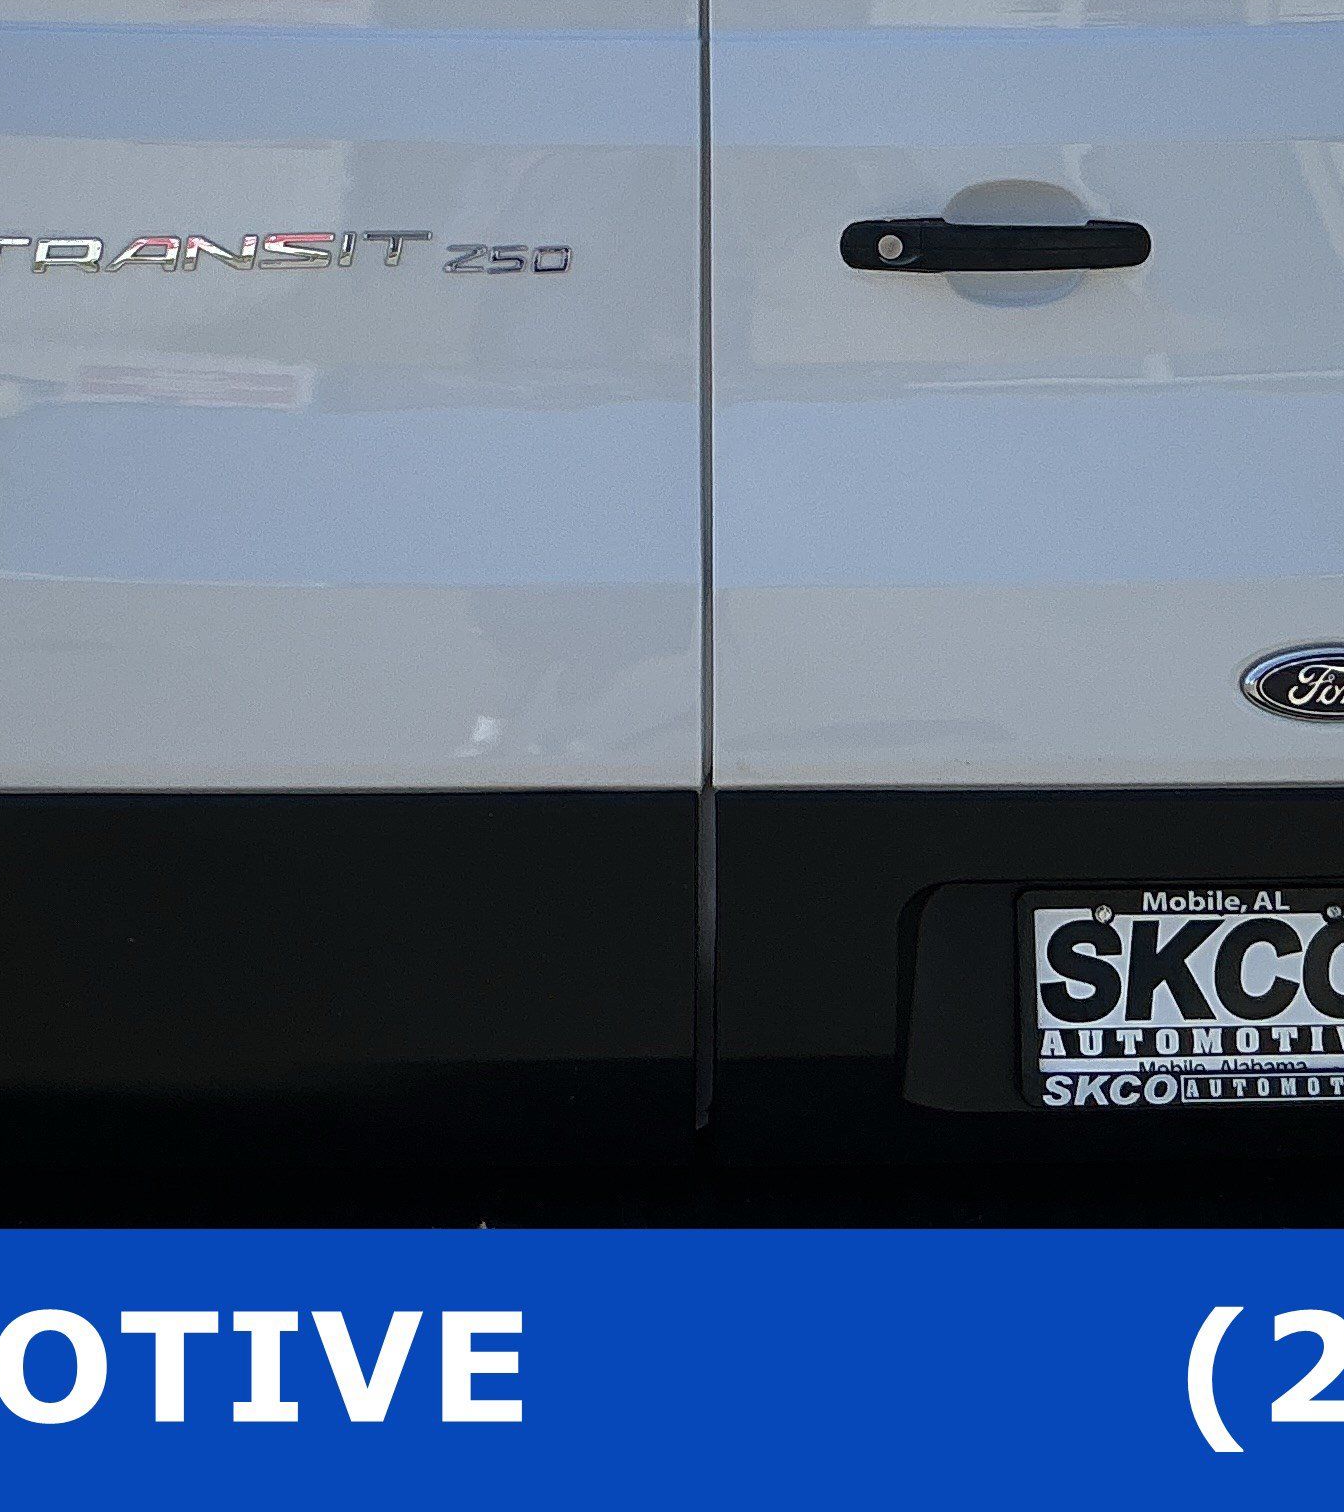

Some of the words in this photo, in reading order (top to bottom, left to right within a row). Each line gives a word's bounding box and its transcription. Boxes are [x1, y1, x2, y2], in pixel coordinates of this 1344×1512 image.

[442, 242, 573, 274] 250
[1142, 890, 1247, 913] Mobile,
[1252, 891, 1291, 911] AL
[1042, 1074, 1181, 1106] SKCO
